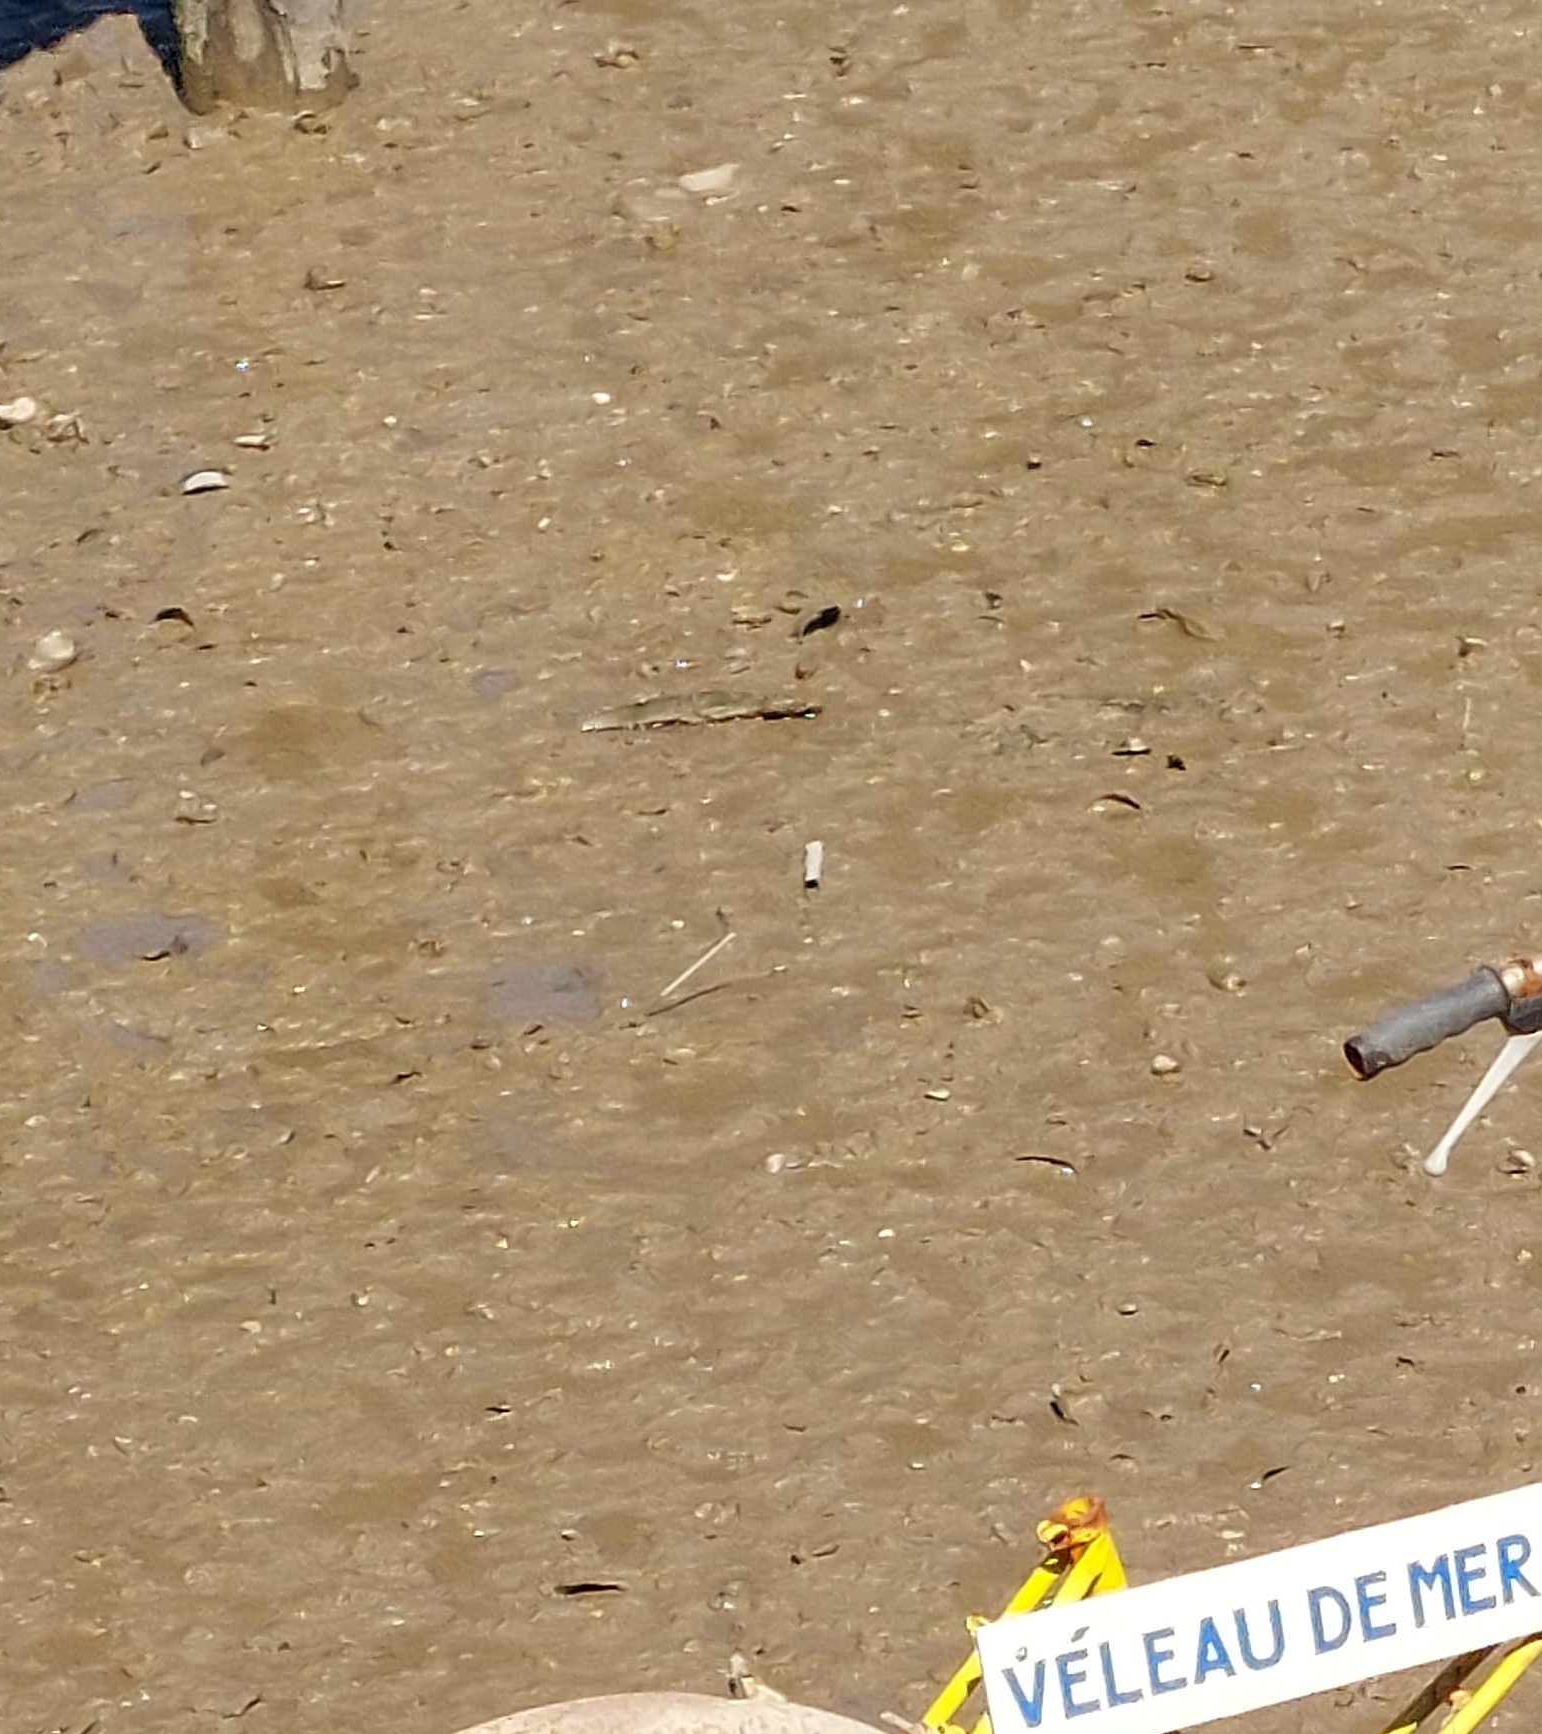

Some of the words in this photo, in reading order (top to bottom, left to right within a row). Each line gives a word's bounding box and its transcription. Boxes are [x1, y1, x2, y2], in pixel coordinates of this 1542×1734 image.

[1000, 1598, 1286, 1729] VÉLEAU
[1306, 1571, 1397, 1656] DE
[1406, 1533, 1542, 1629] MER
